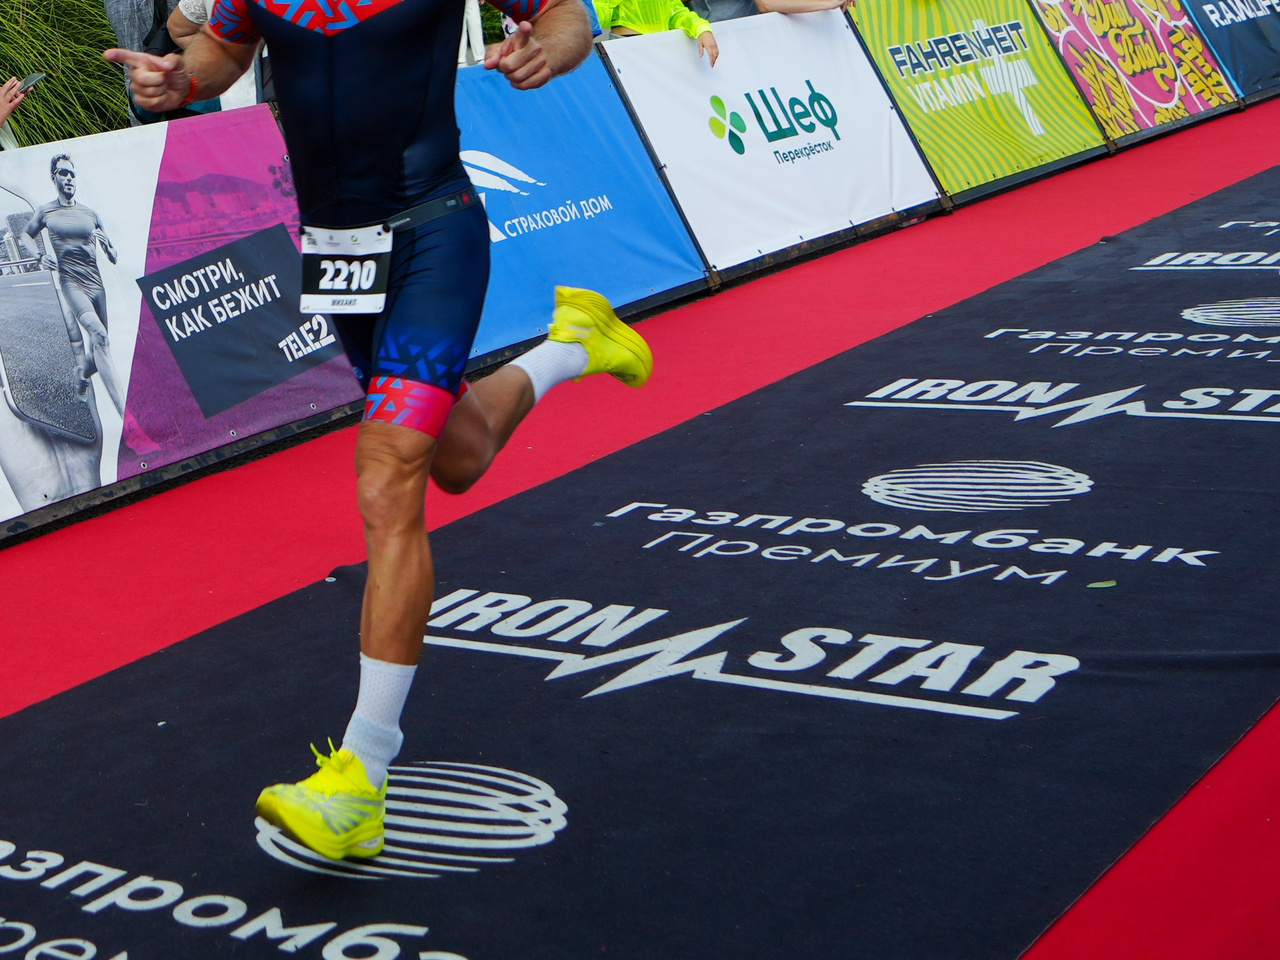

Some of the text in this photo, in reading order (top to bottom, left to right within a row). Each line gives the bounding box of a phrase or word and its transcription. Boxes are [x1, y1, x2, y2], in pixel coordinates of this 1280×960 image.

[887, 20, 1029, 79] FAHRENHEIT
[1108, 17, 1177, 93] Bubl
[744, 79, 841, 143] Шеф
[907, 70, 986, 114] VITAMIN
[504, 200, 581, 237] СТРАХОВОЙ
[580, 194, 613, 220] ДОМ
[151, 257, 245, 311] СМОТРИ,
[319, 259, 377, 292] 2210
[165, 274, 282, 342] КАК БЕЖИТ
[278, 314, 336, 363] TELE2
[1029, 342, 1280, 362] Преми
[865, 378, 1080, 404] IRON
[606, 501, 1221, 567] Газпромбанк
[642, 530, 1068, 585] Премиум
[426, 589, 1080, 703] IRON STAR
